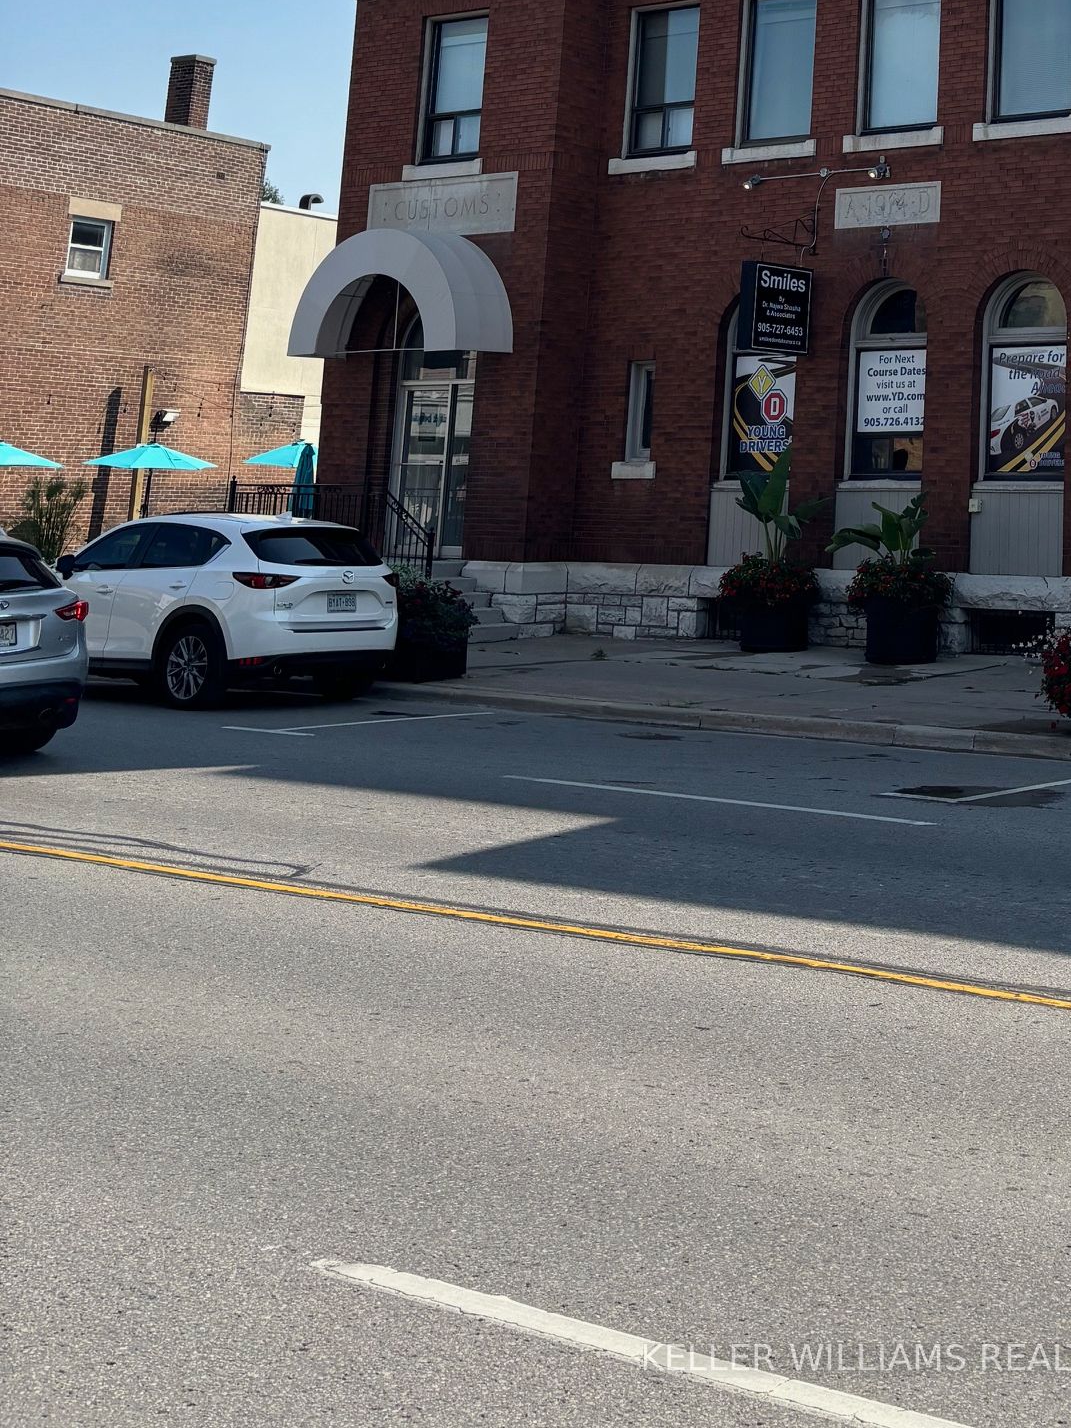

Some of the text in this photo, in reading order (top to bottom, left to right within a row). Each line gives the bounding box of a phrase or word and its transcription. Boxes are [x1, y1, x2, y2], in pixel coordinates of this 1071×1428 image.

[394, 194, 489, 222] CUSTOMS
[761, 270, 806, 292] Smiles
[758, 322, 803, 336] 905-727-6453
[879, 354, 915, 364] For Next
[1000, 350, 1065, 365] Prepare for
[867, 366, 927, 377] Course Dates
[1009, 369, 1027, 380] the
[876, 380, 916, 389] visit us at
[866, 392, 926, 401] www.YD.com
[771, 397, 779, 415] D
[882, 404, 908, 414] or call
[864, 417, 926, 427] 905.726.4132
[747, 425, 786, 438] YOUNG
[740, 438, 790, 452] DRIVERS
